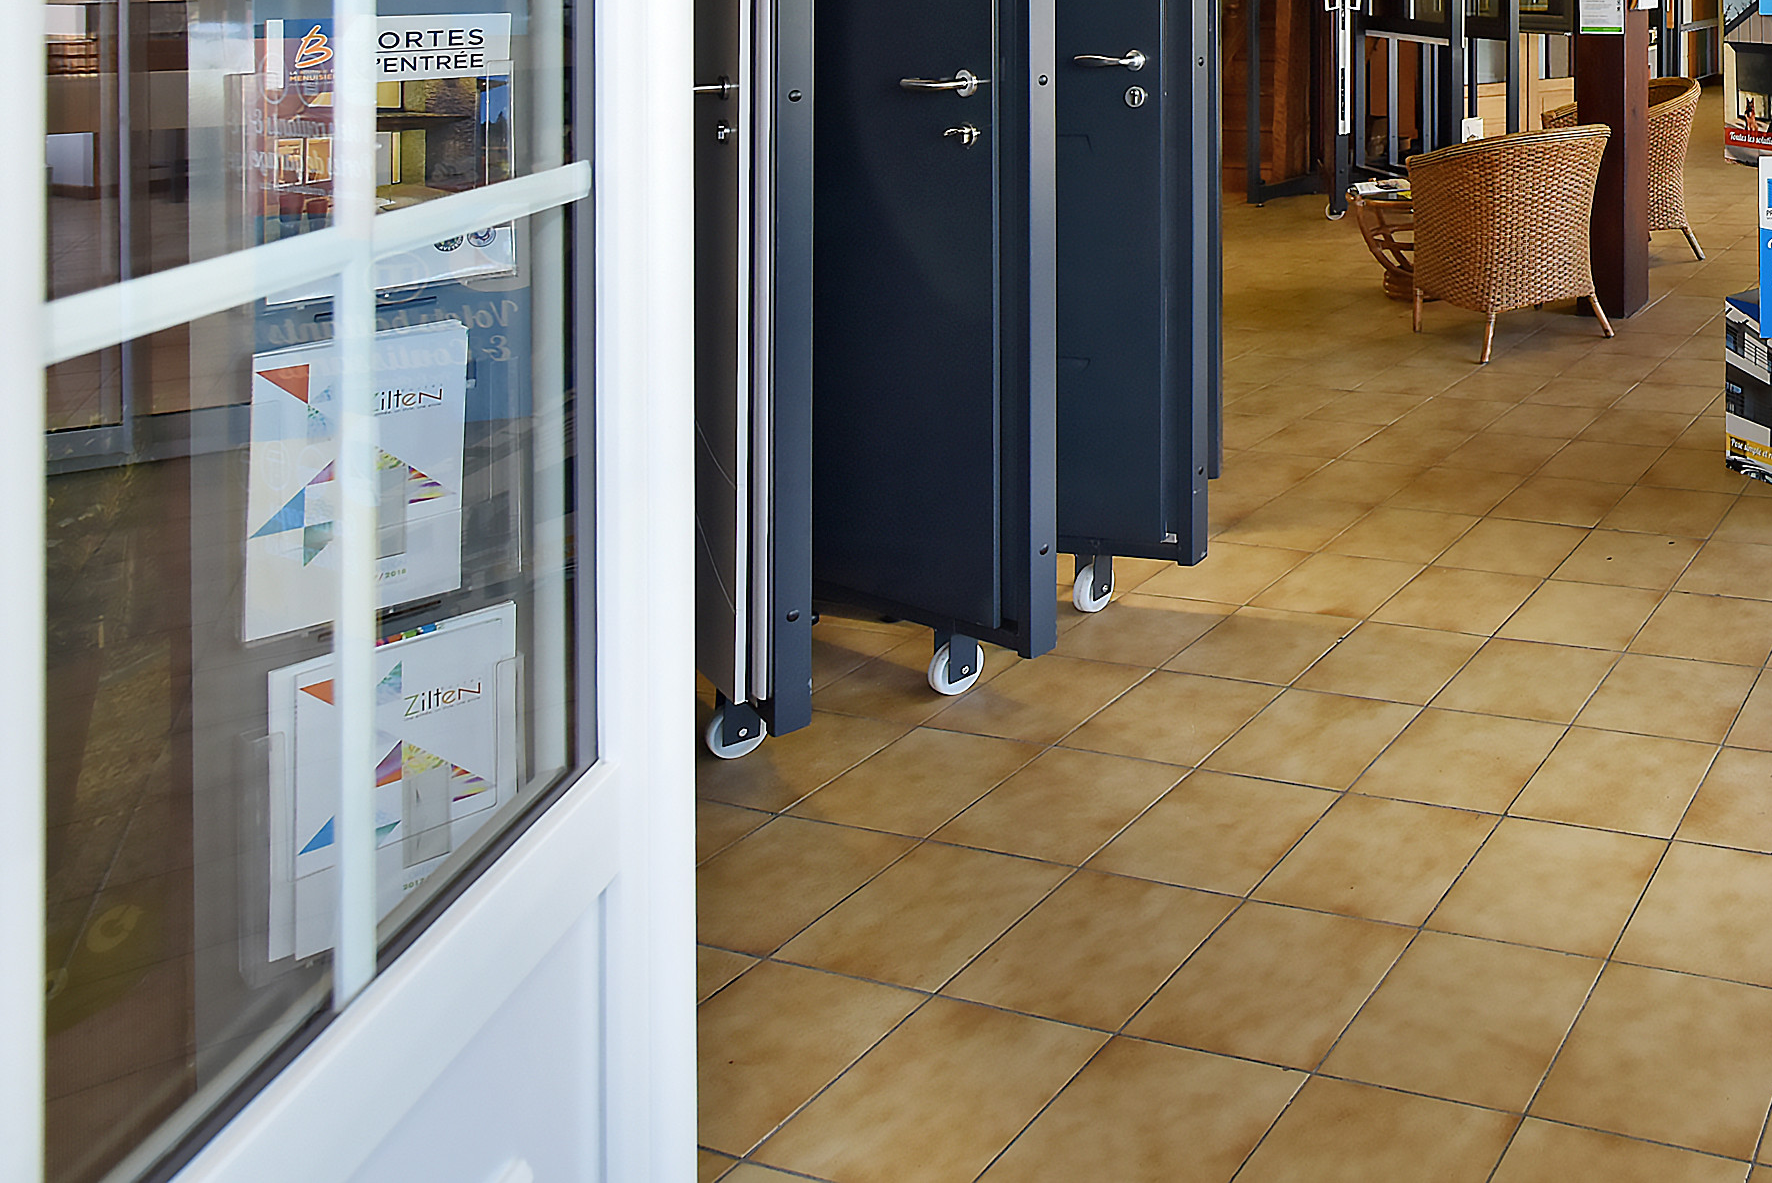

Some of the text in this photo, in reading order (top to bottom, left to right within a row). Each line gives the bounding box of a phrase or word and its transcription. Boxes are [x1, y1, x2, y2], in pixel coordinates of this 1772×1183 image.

[377, 29, 485, 50] ORTES
[1729, 131, 1747, 142] Toutes
[1747, 132, 1755, 144] les
